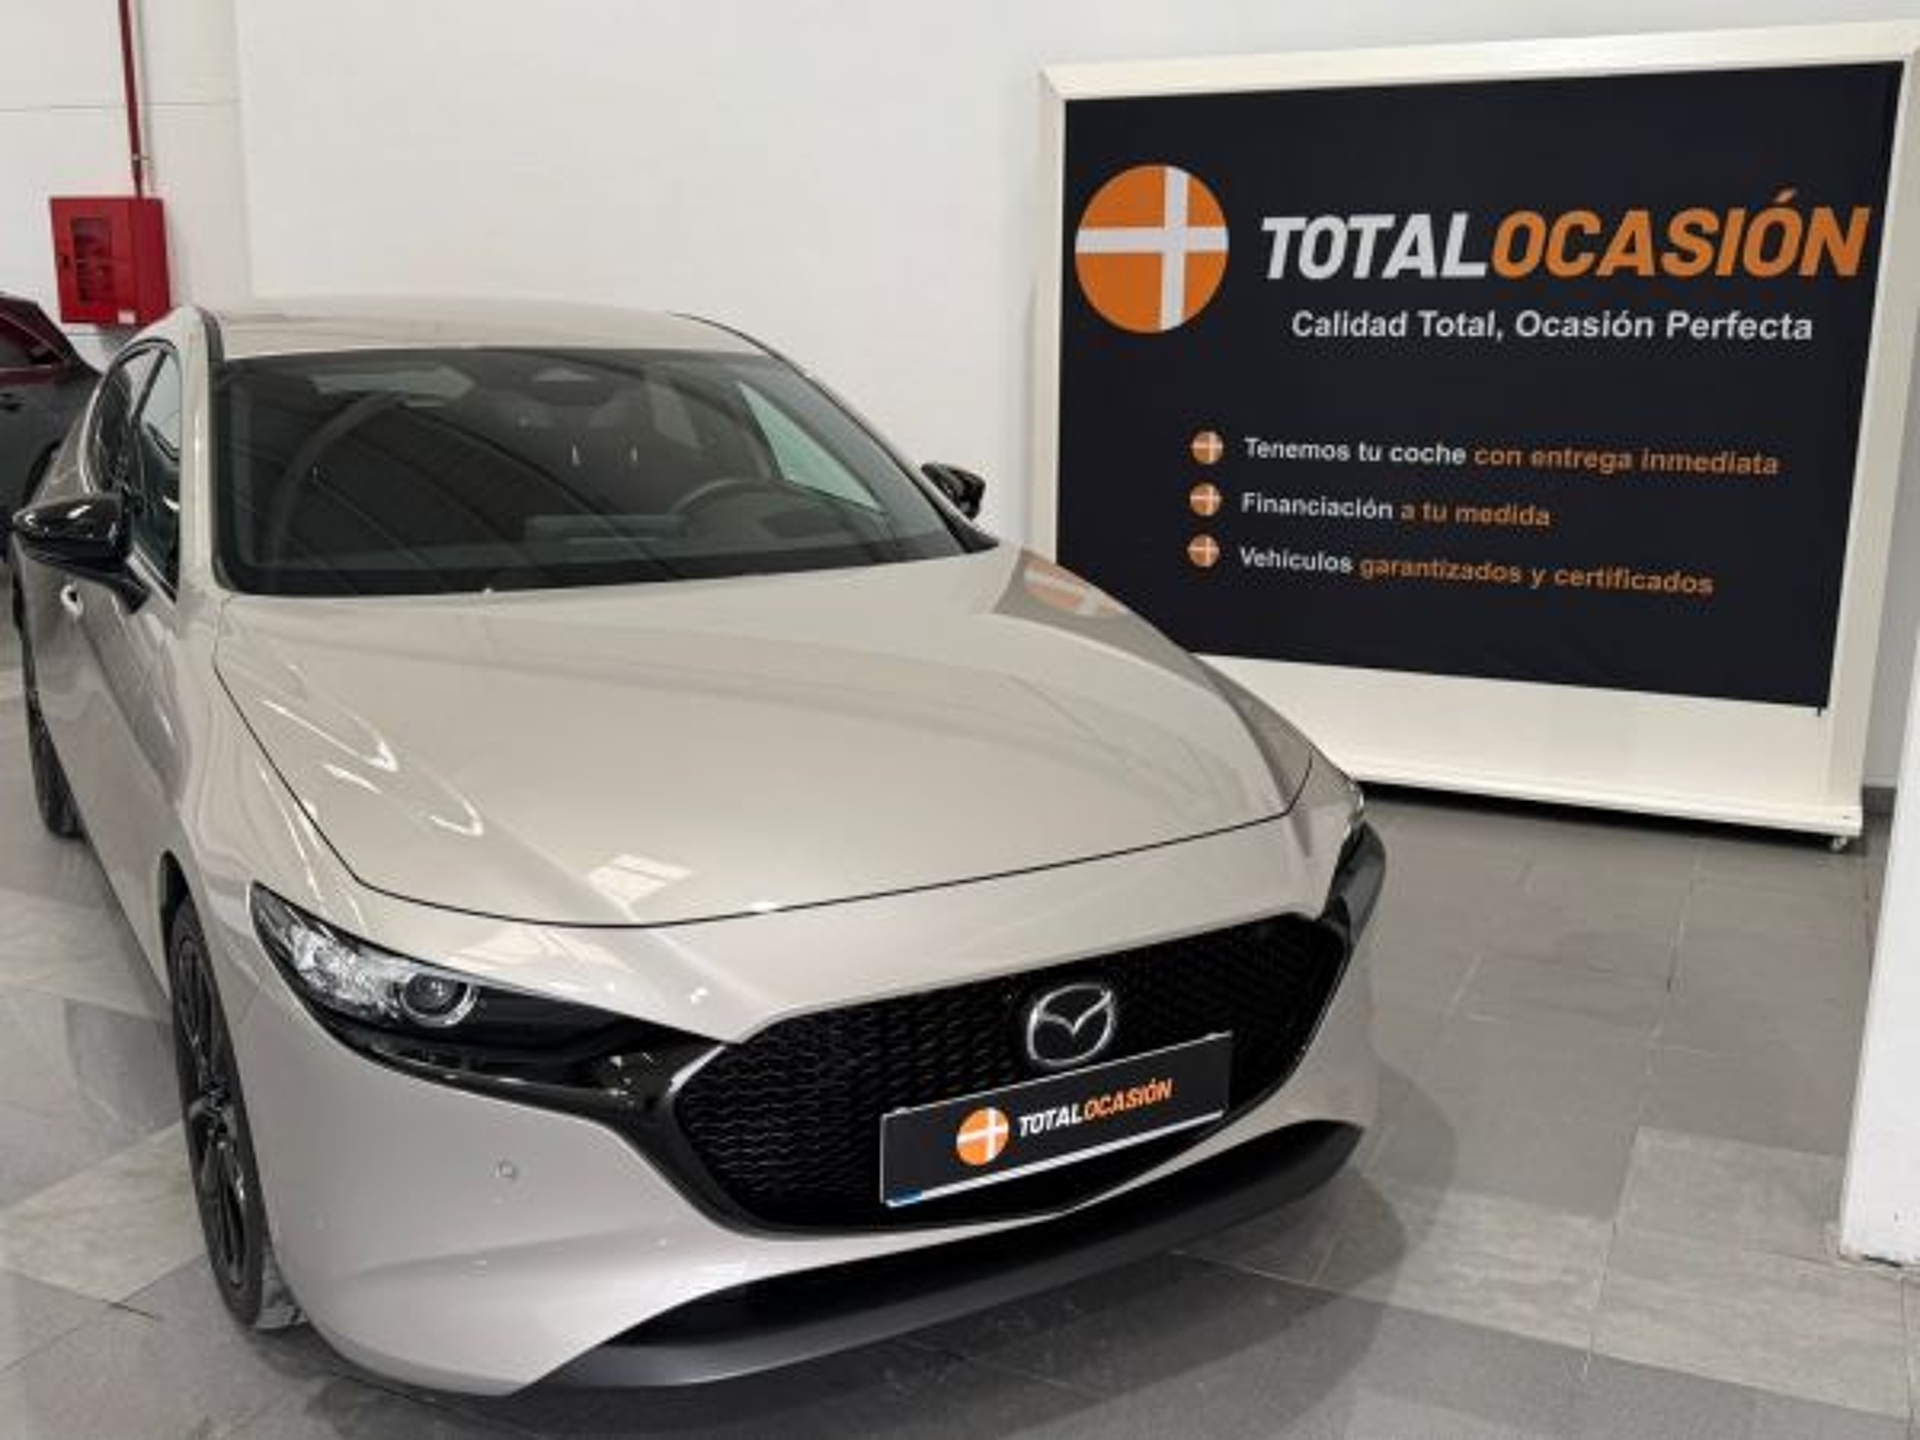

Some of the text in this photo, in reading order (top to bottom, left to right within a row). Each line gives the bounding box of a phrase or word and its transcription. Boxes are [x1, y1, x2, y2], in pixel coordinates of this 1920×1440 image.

[1292, 309, 1813, 341] Calidad Total, Ocasión Perfecta
[1244, 438, 1779, 476] Tenemos tu coche con entrega inmediata
[1241, 492, 1551, 527] Financiación a tu medida
[1359, 558, 1521, 584] garantizados
[1531, 567, 1547, 590] y
[1554, 567, 1714, 595] certificados
